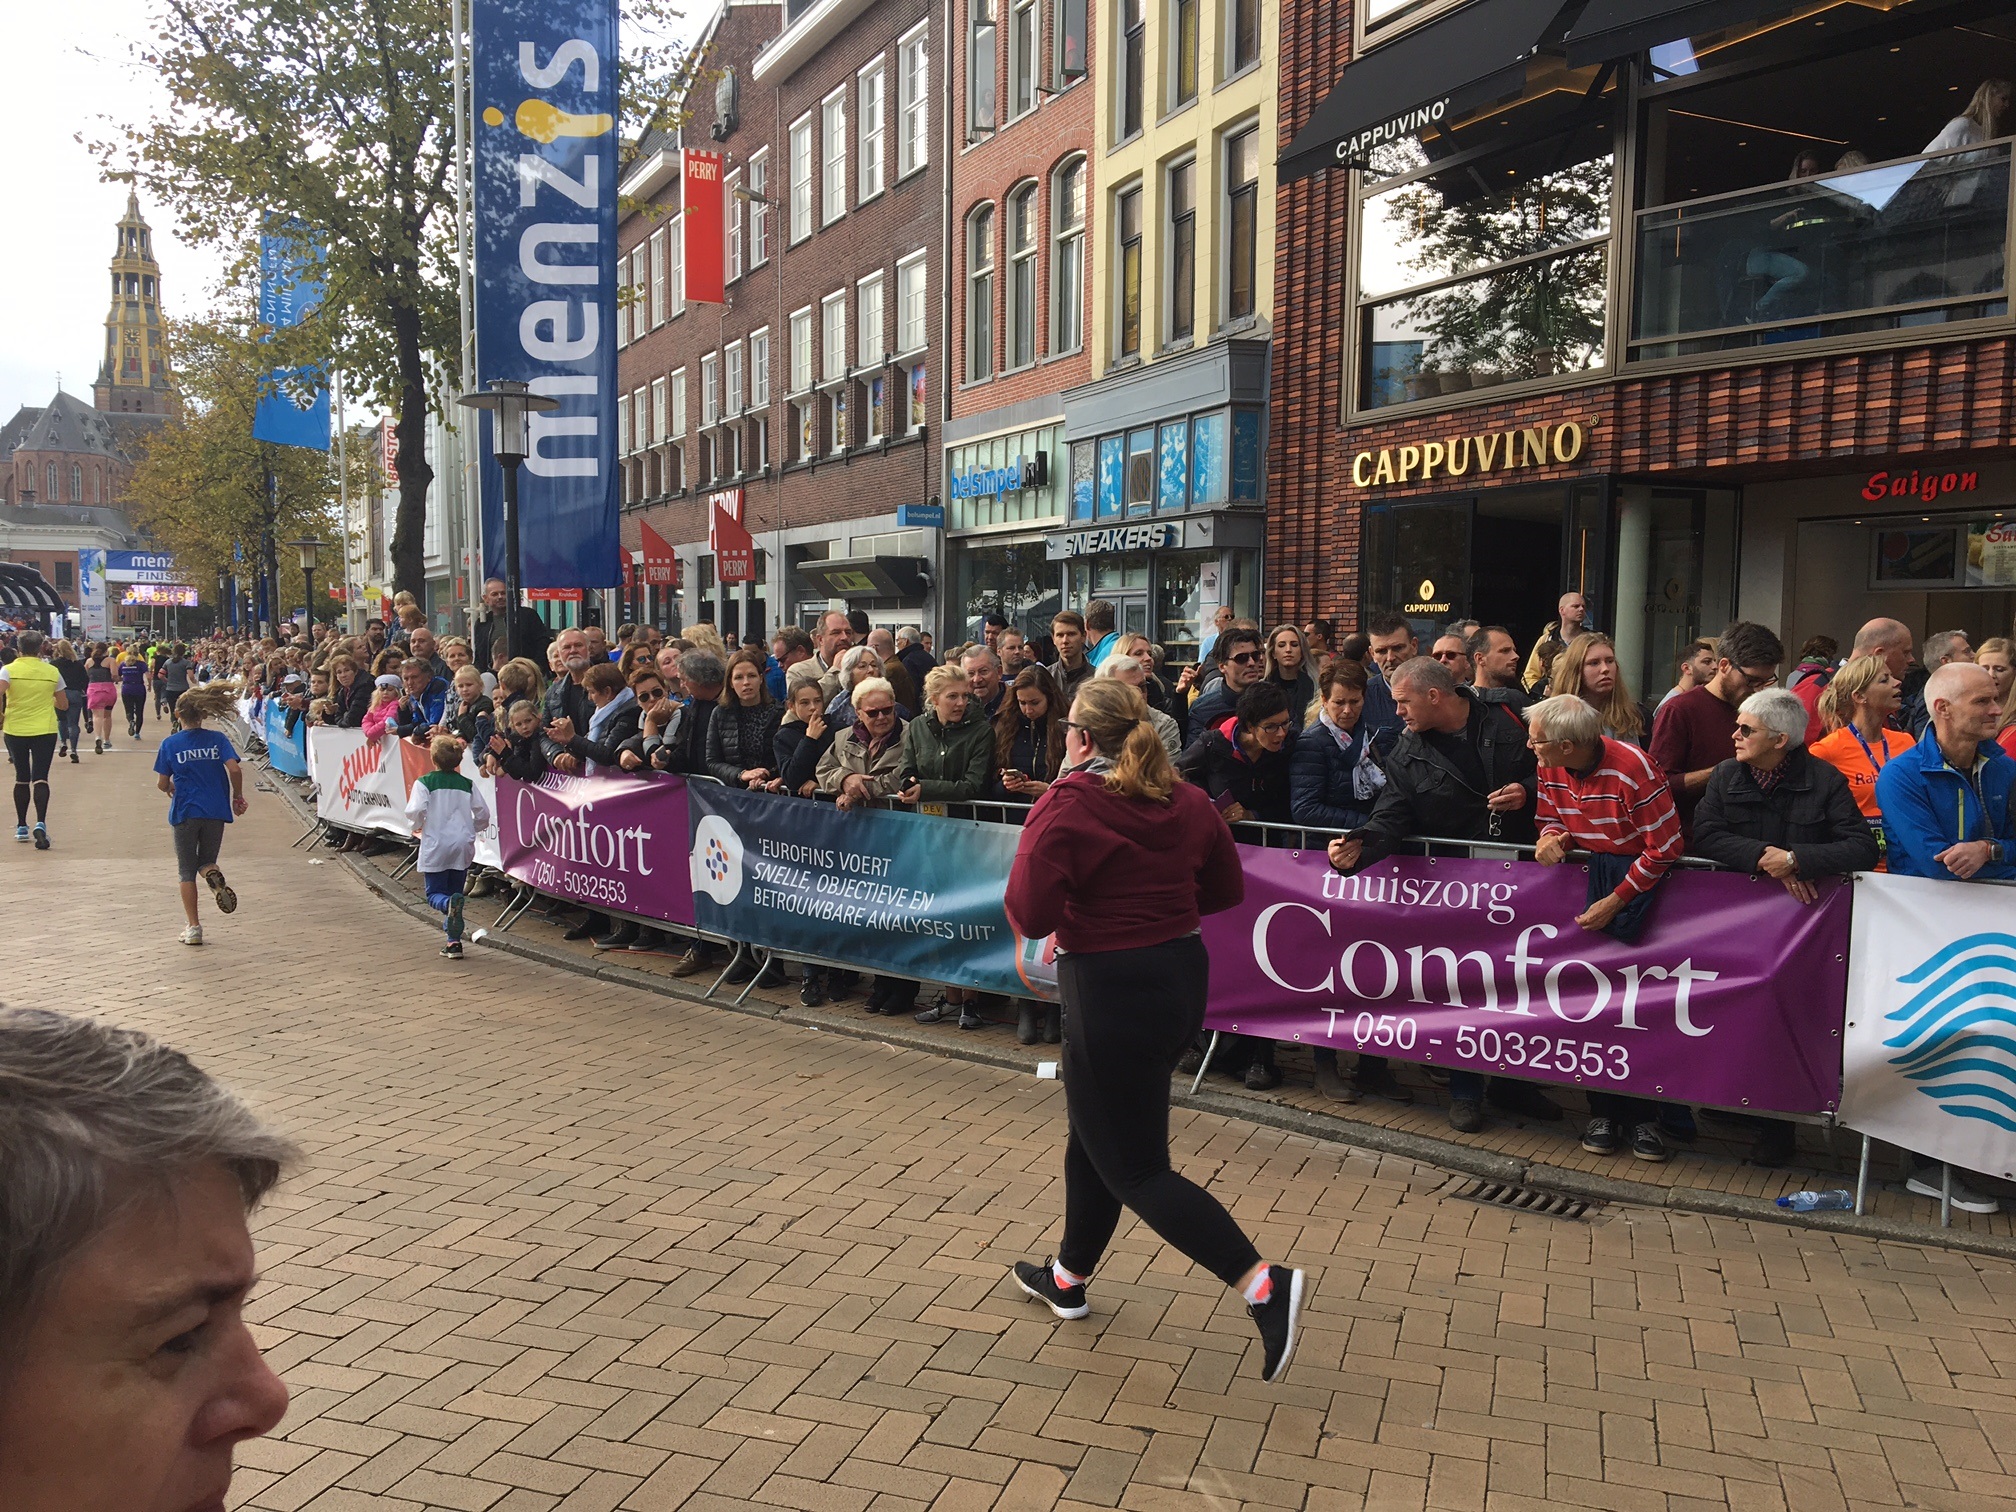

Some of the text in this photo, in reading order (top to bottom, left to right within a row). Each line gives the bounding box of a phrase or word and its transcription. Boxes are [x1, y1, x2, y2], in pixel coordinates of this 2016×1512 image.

[688, 160, 718, 181] PERRY
[482, 39, 613, 478] menzis
[1861, 470, 1977, 501] Saigon
[1064, 524, 1167, 556] SNEAKERS
[131, 556, 175, 568] menz
[137, 571, 179, 581] FINIS
[649, 566, 671, 581] PERRY
[723, 560, 748, 577] PERRY
[175, 745, 220, 764] UNIVÉ
[515, 788, 654, 876] Comfort
[758, 837, 892, 877] 'EUROFINS VOERT
[531, 858, 539, 879] T
[538, 862, 556, 887] 050
[564, 871, 627, 904] 5032553
[752, 861, 935, 912] SNELLE, OBJECTIEVE EN
[753, 886, 996, 941] BETROUWBARE ANALYSES UIT'
[1252, 902, 1720, 1037] Comfort
[1320, 1007, 1345, 1038] T
[1353, 1011, 1418, 1050] 050
[1455, 1025, 1630, 1081] 5032553
